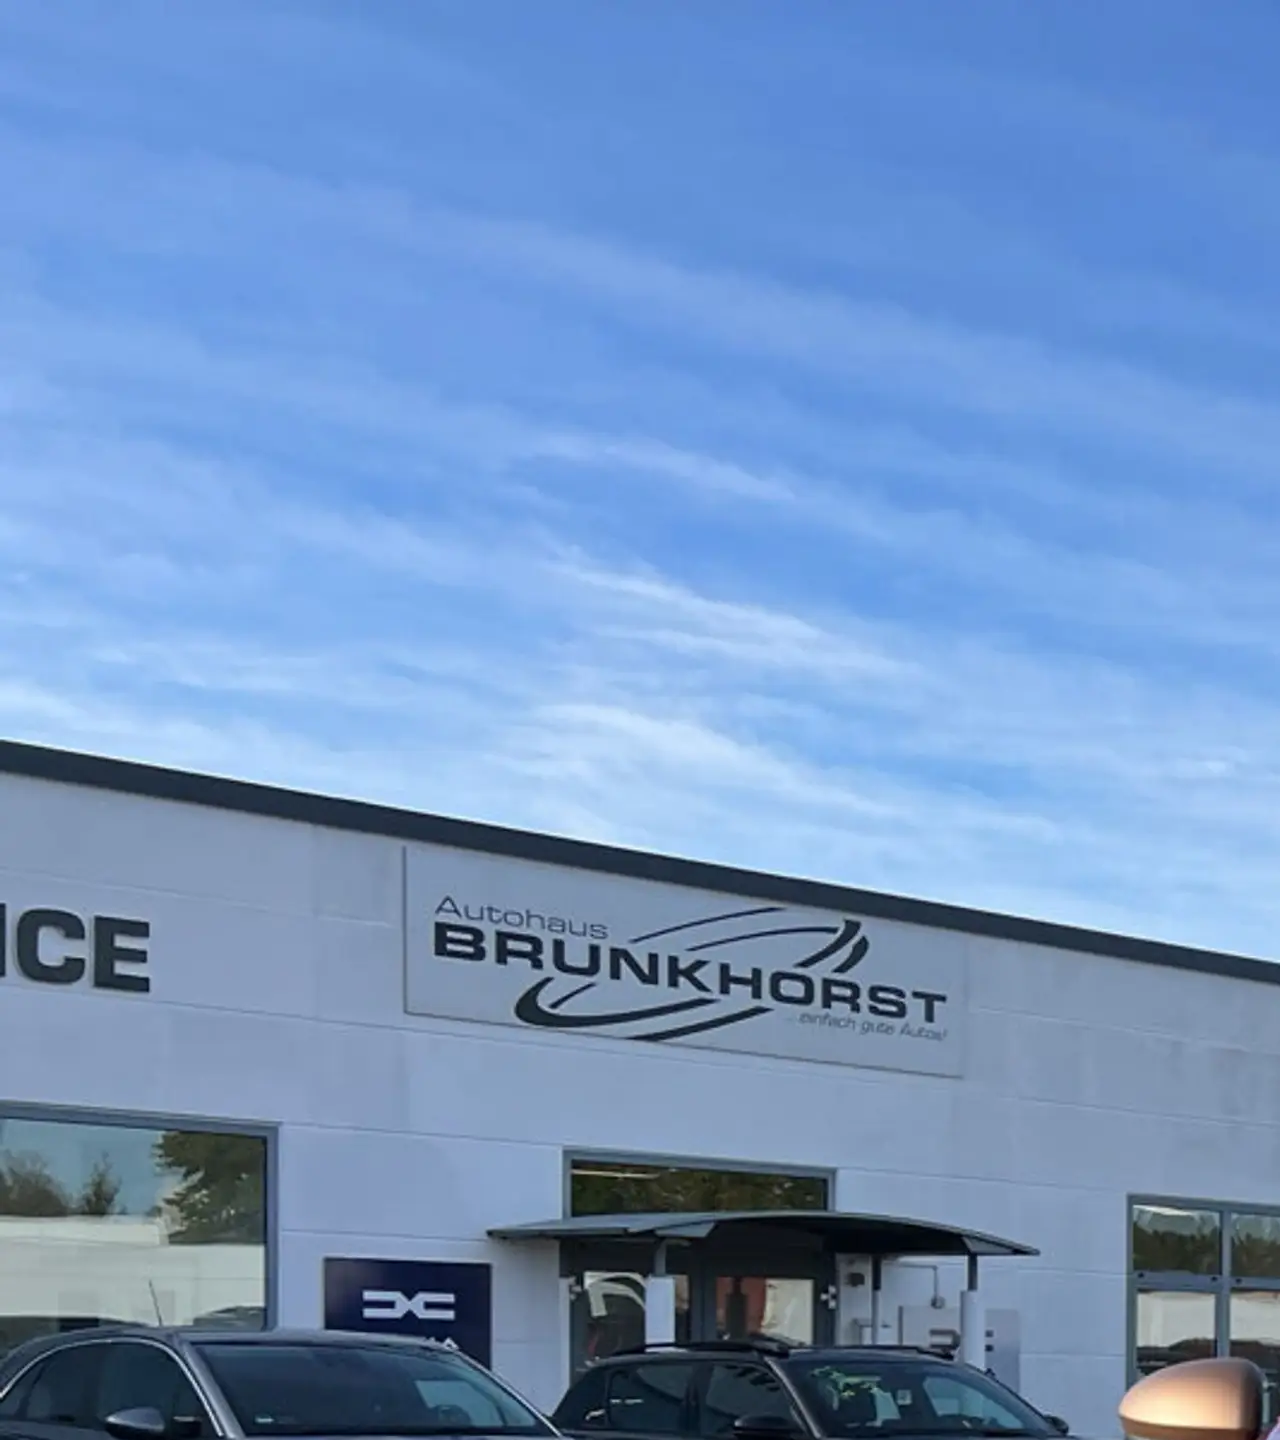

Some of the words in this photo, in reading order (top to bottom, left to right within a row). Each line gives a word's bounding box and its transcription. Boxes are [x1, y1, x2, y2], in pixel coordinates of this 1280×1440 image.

[0, 902, 151, 993] CE
[434, 894, 609, 940] Autohaus
[433, 921, 947, 1023] BRUNKHORST
